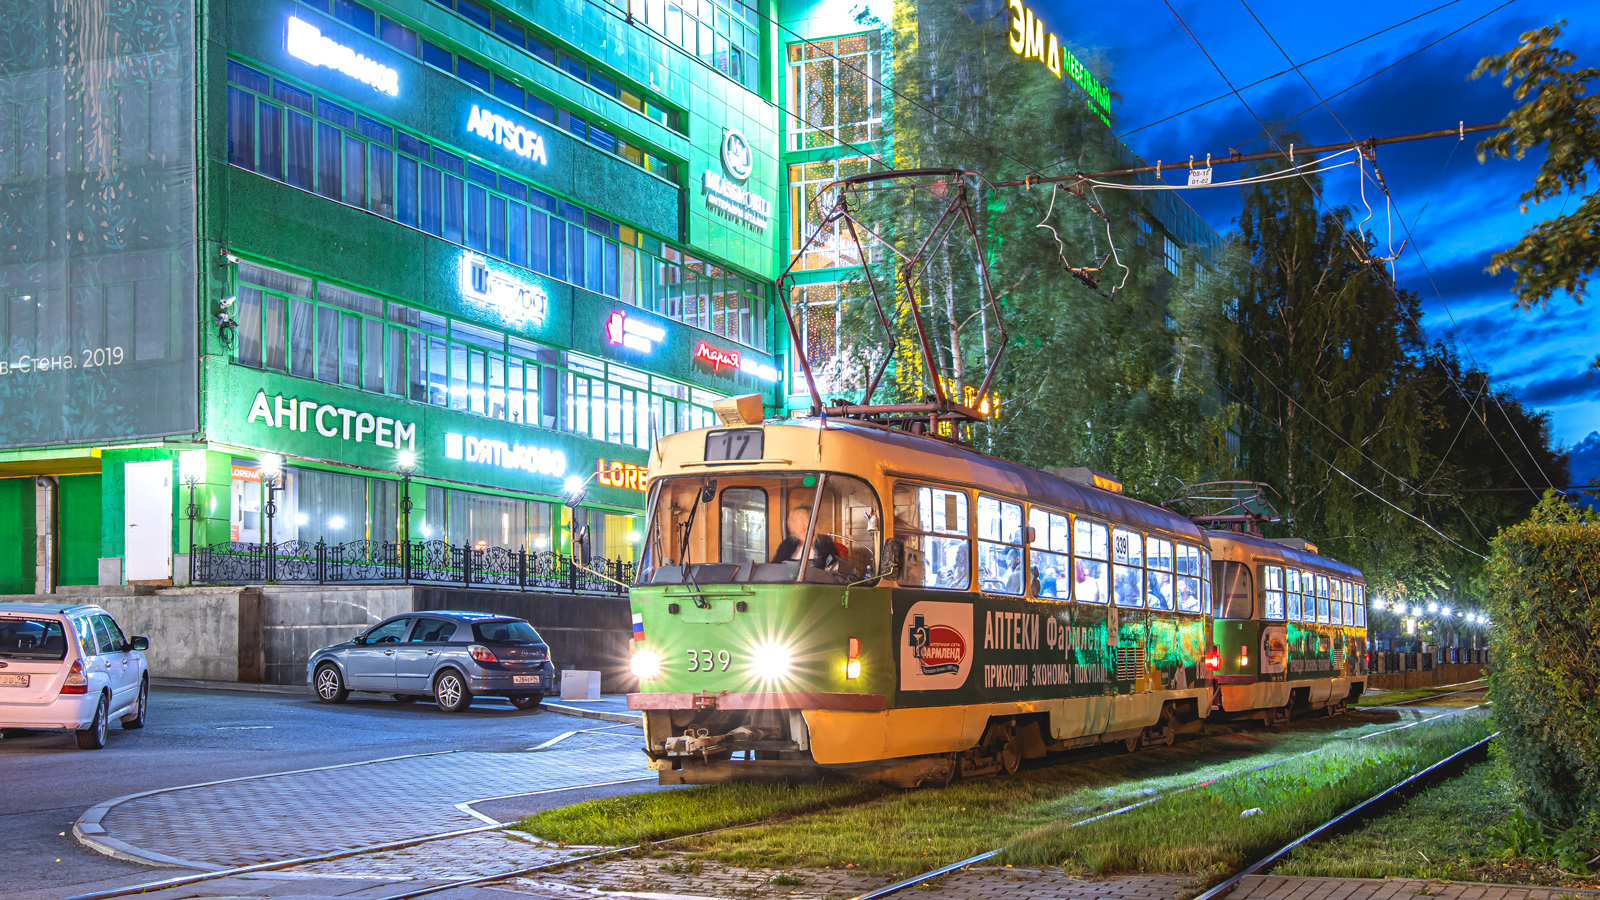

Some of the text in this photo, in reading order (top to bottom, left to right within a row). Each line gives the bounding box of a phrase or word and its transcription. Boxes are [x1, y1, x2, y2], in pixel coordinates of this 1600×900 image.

[466, 104, 547, 166] ARTSOFA
[18, 355, 78, 373] Стена.
[82, 346, 124, 368] 2019
[246, 391, 416, 451] АНГСТРЕМ
[722, 435, 751, 460] 17
[231, 468, 260, 479] LORENA
[1116, 536, 1127, 555] 339
[984, 611, 1040, 650] АПТЕКИ
[686, 649, 732, 672] 339
[984, 664, 1028, 691] ПРИХОДИ!
[1031, 664, 1072, 686] ЭКОНОМЬ!
